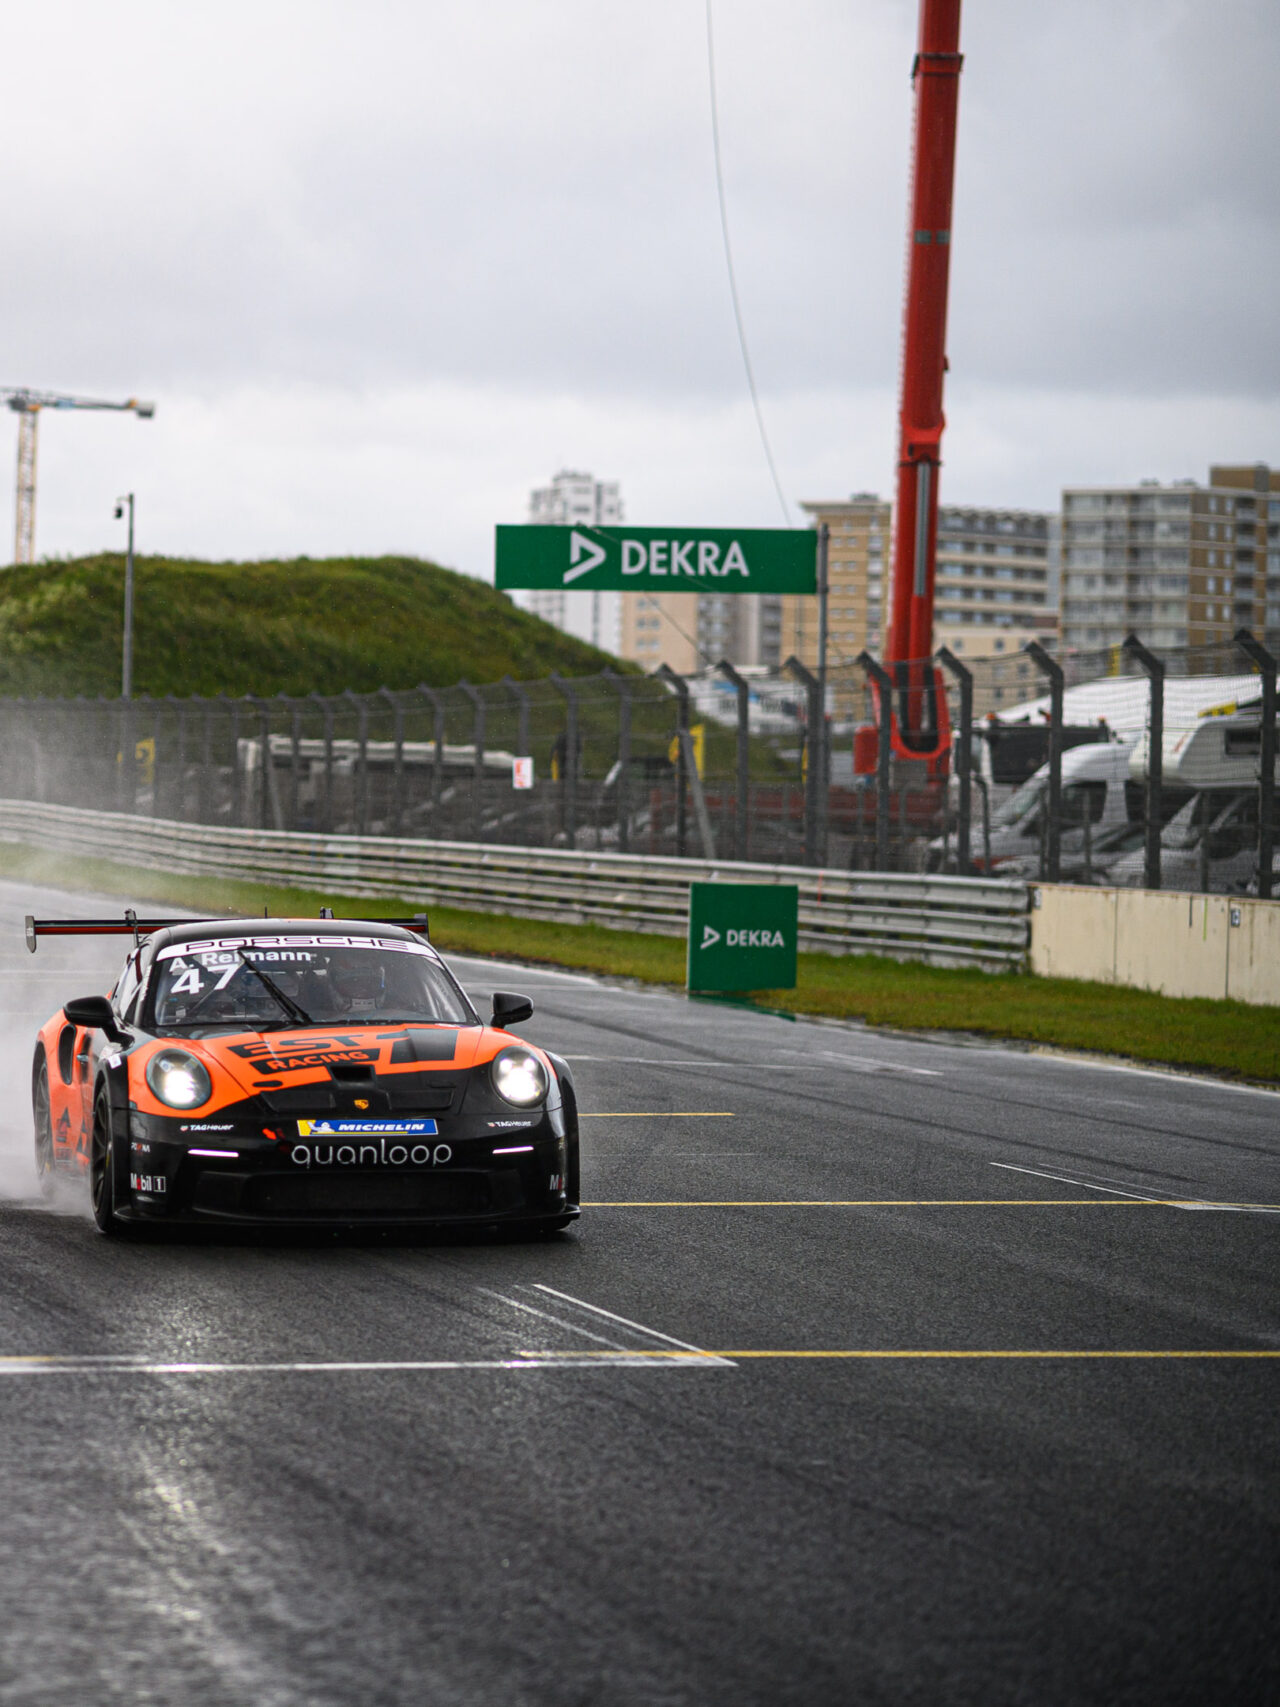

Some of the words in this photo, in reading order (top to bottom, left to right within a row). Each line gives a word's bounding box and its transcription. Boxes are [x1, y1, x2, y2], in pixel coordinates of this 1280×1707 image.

[621, 539, 750, 577] DEKRA
[185, 937, 409, 952] PORSCHE
[726, 929, 785, 947] DEKRA
[171, 963, 240, 995] 47
[266, 1051, 370, 1071] RACING
[338, 1123, 425, 1131] MICHELIN
[291, 1138, 452, 1169] quanloop
[130, 1173, 152, 1191] Mobil
